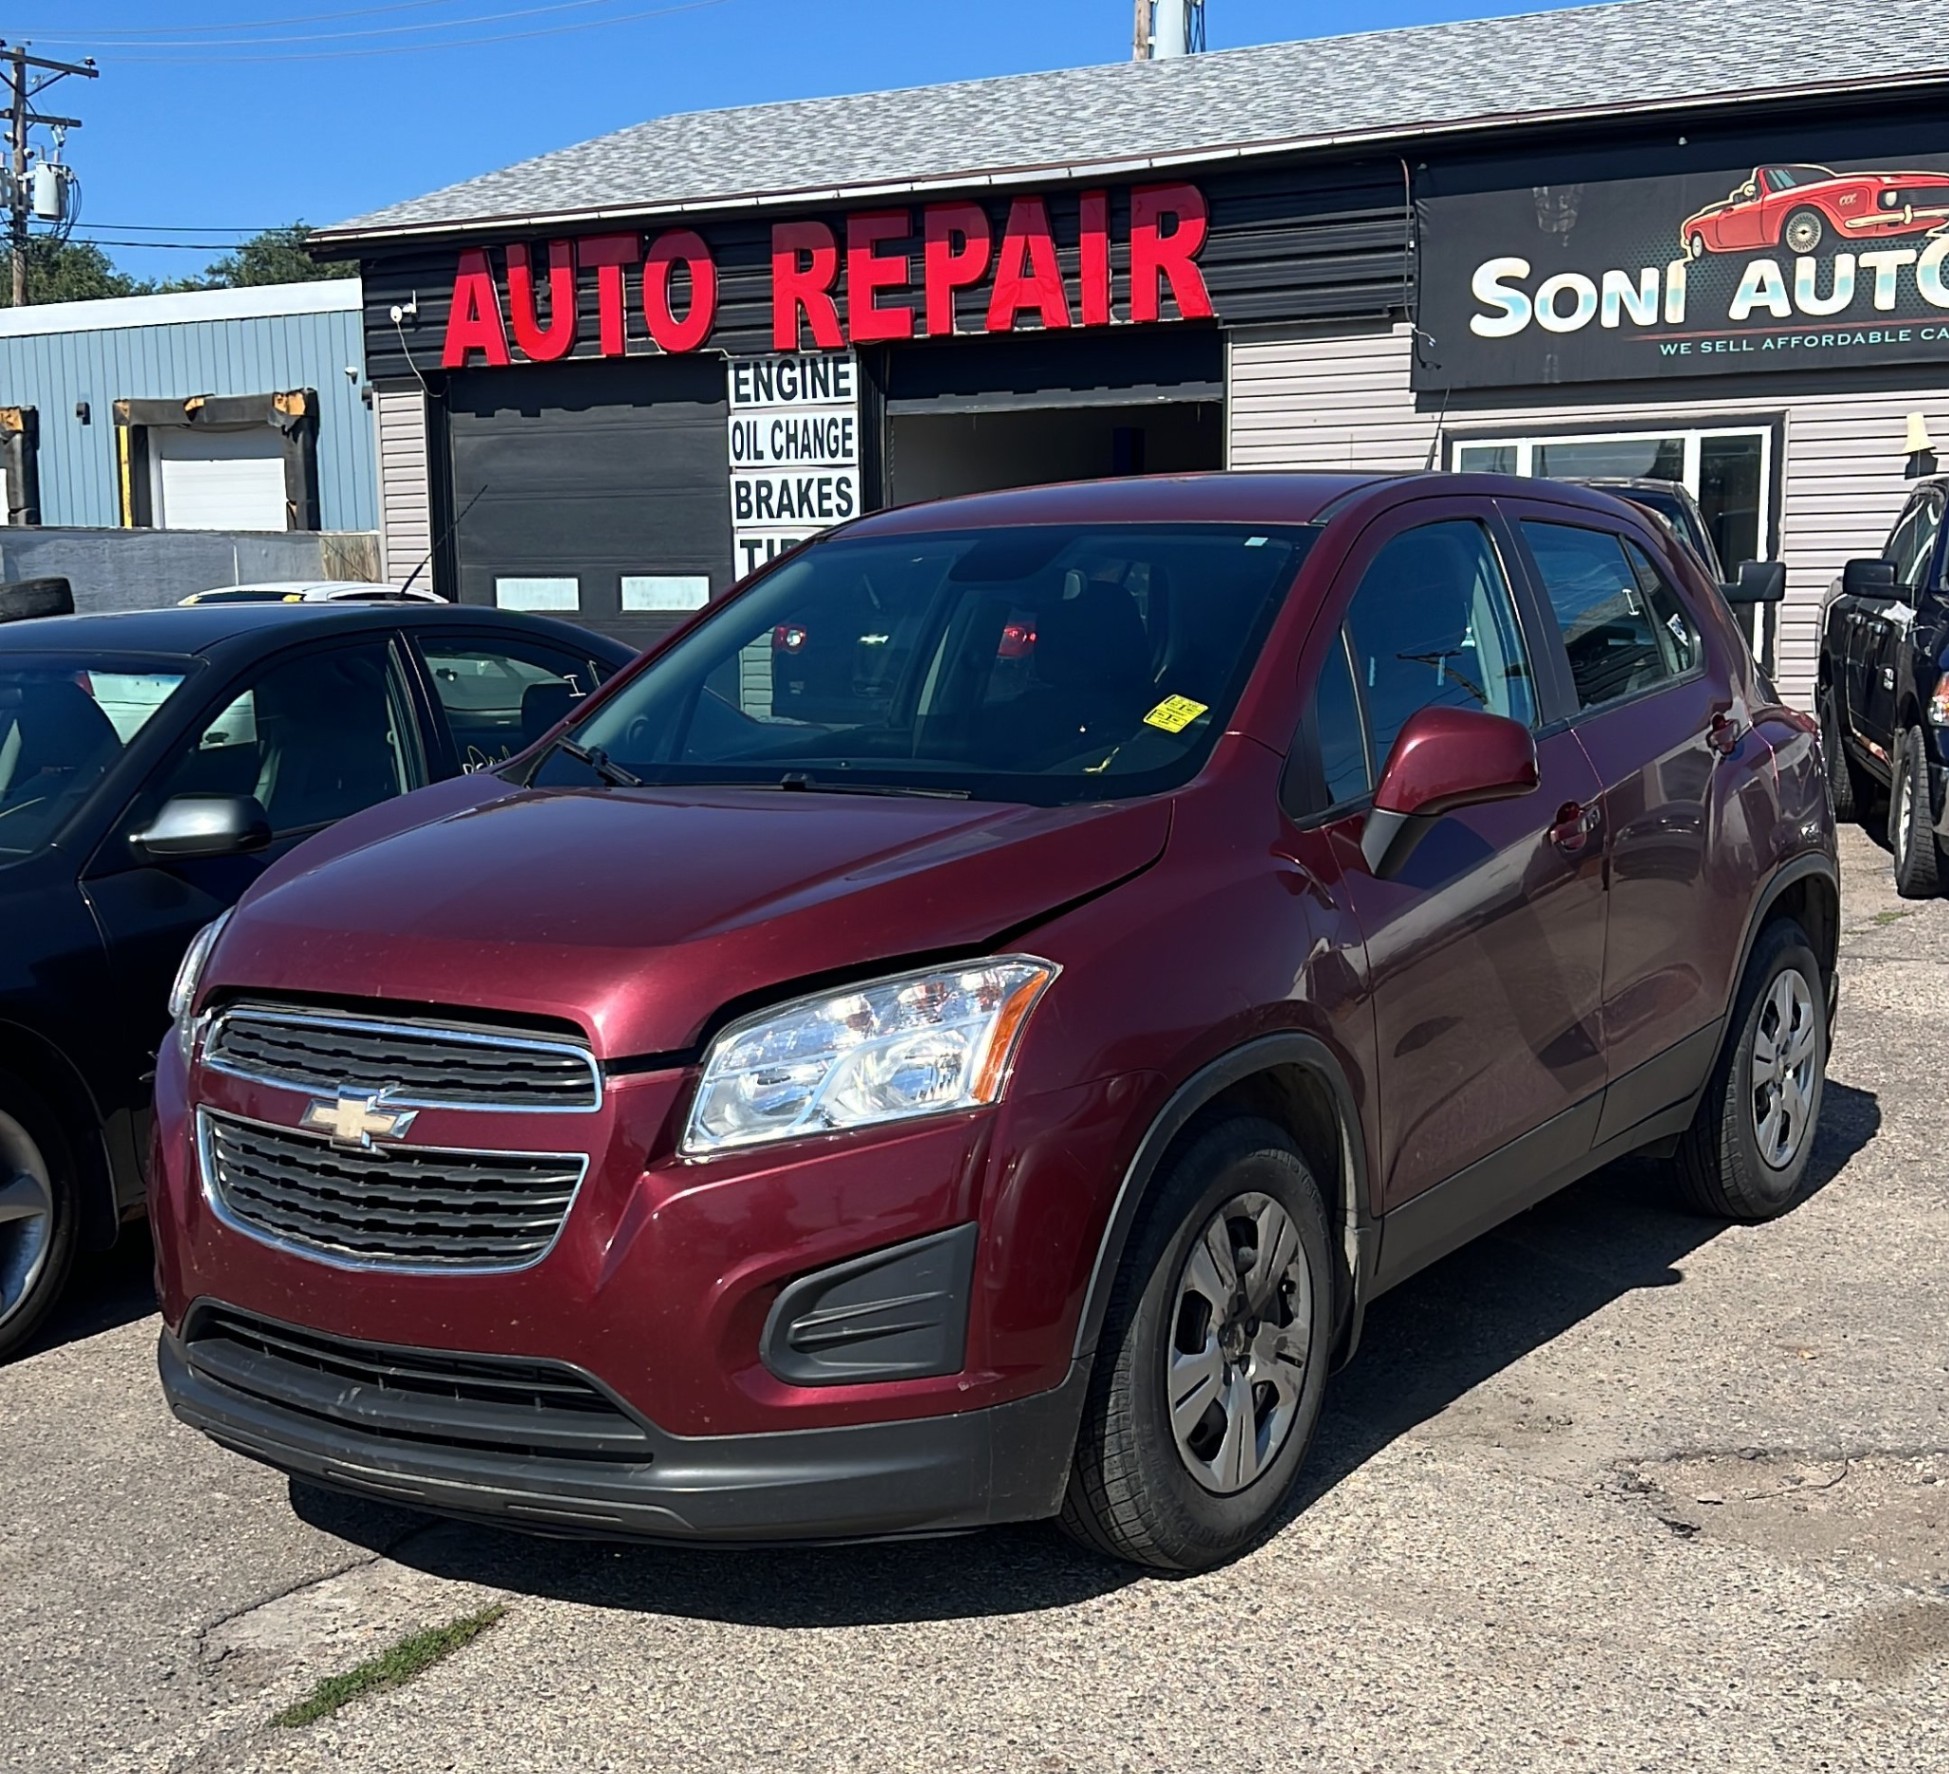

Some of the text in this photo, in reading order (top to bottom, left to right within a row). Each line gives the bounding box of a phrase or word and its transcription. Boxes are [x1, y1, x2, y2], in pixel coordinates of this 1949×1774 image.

[441, 181, 1215, 368] AUTO REPAIR
[1660, 342, 1692, 356] WE
[1700, 339, 1754, 354] SELL
[1761, 329, 1912, 351] AFFORDABLE
[733, 356, 852, 403] ENGINE
[732, 417, 854, 461] OIL CHANGE
[735, 476, 853, 520] BRAKES
